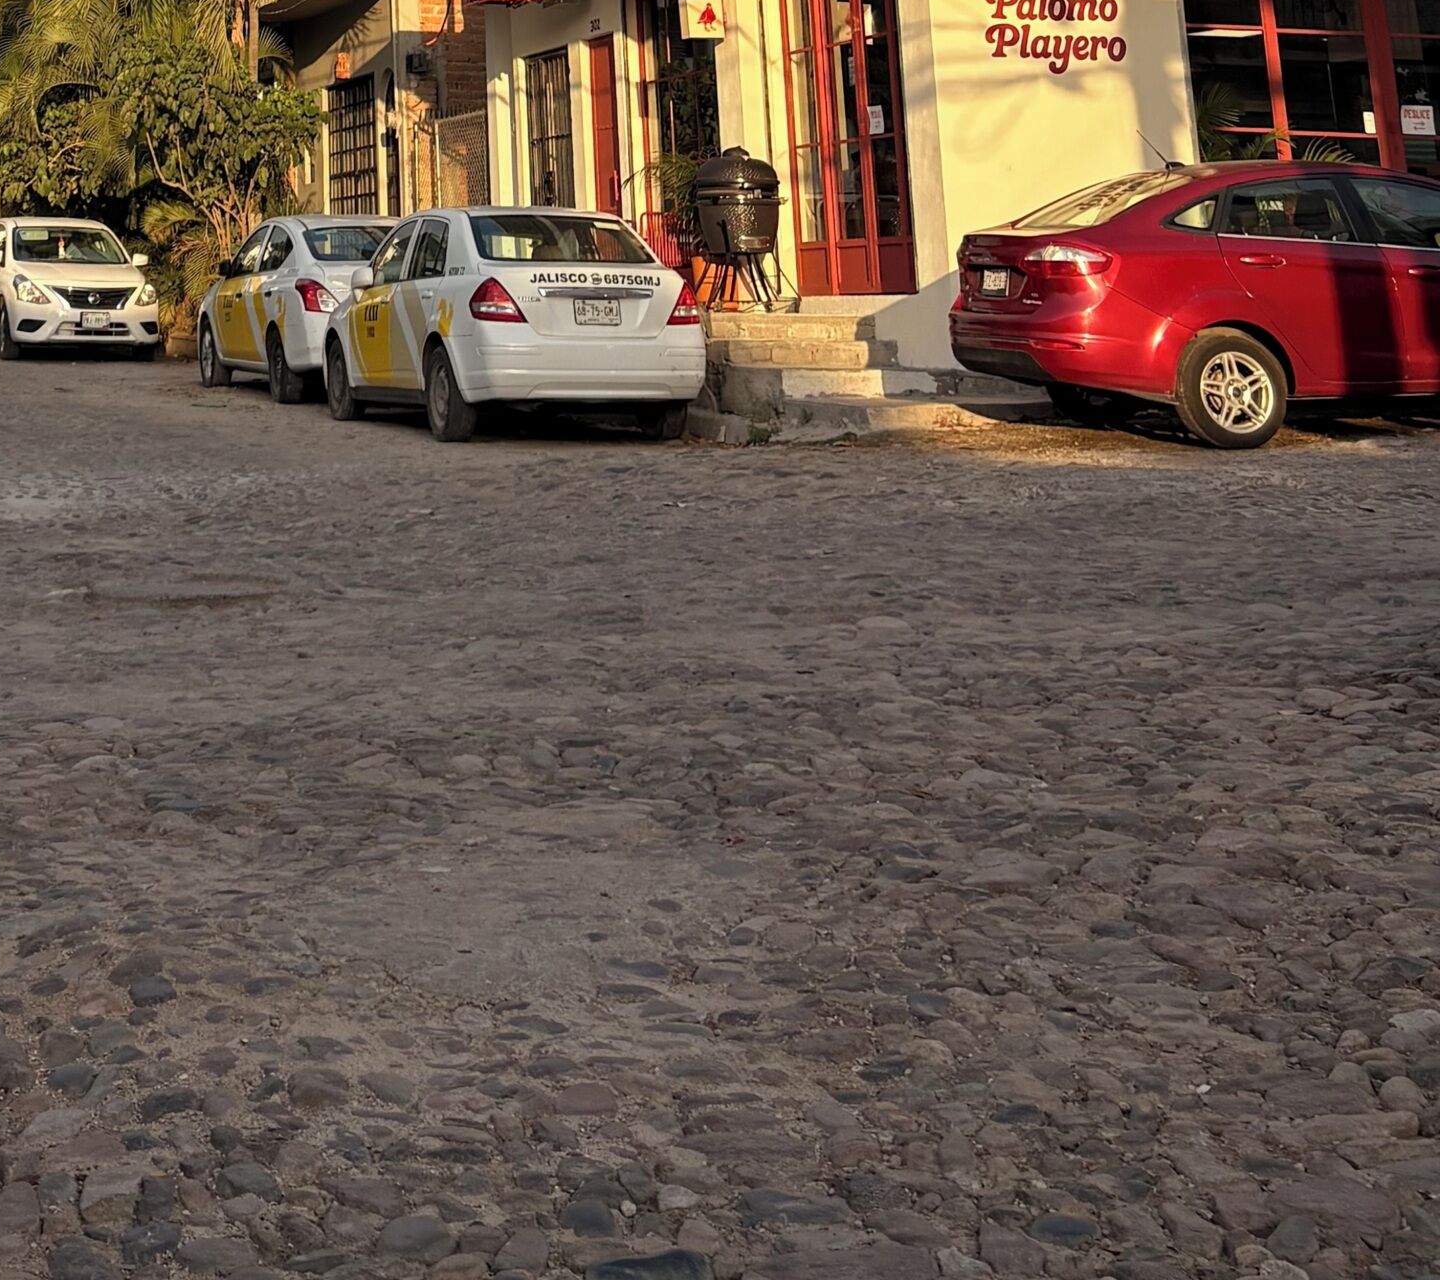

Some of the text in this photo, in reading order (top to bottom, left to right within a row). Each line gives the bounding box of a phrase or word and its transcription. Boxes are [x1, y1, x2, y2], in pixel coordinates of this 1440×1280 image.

[985, 23, 1127, 75] Playero
[530, 273, 661, 286] JALISCO 6875GMJ
